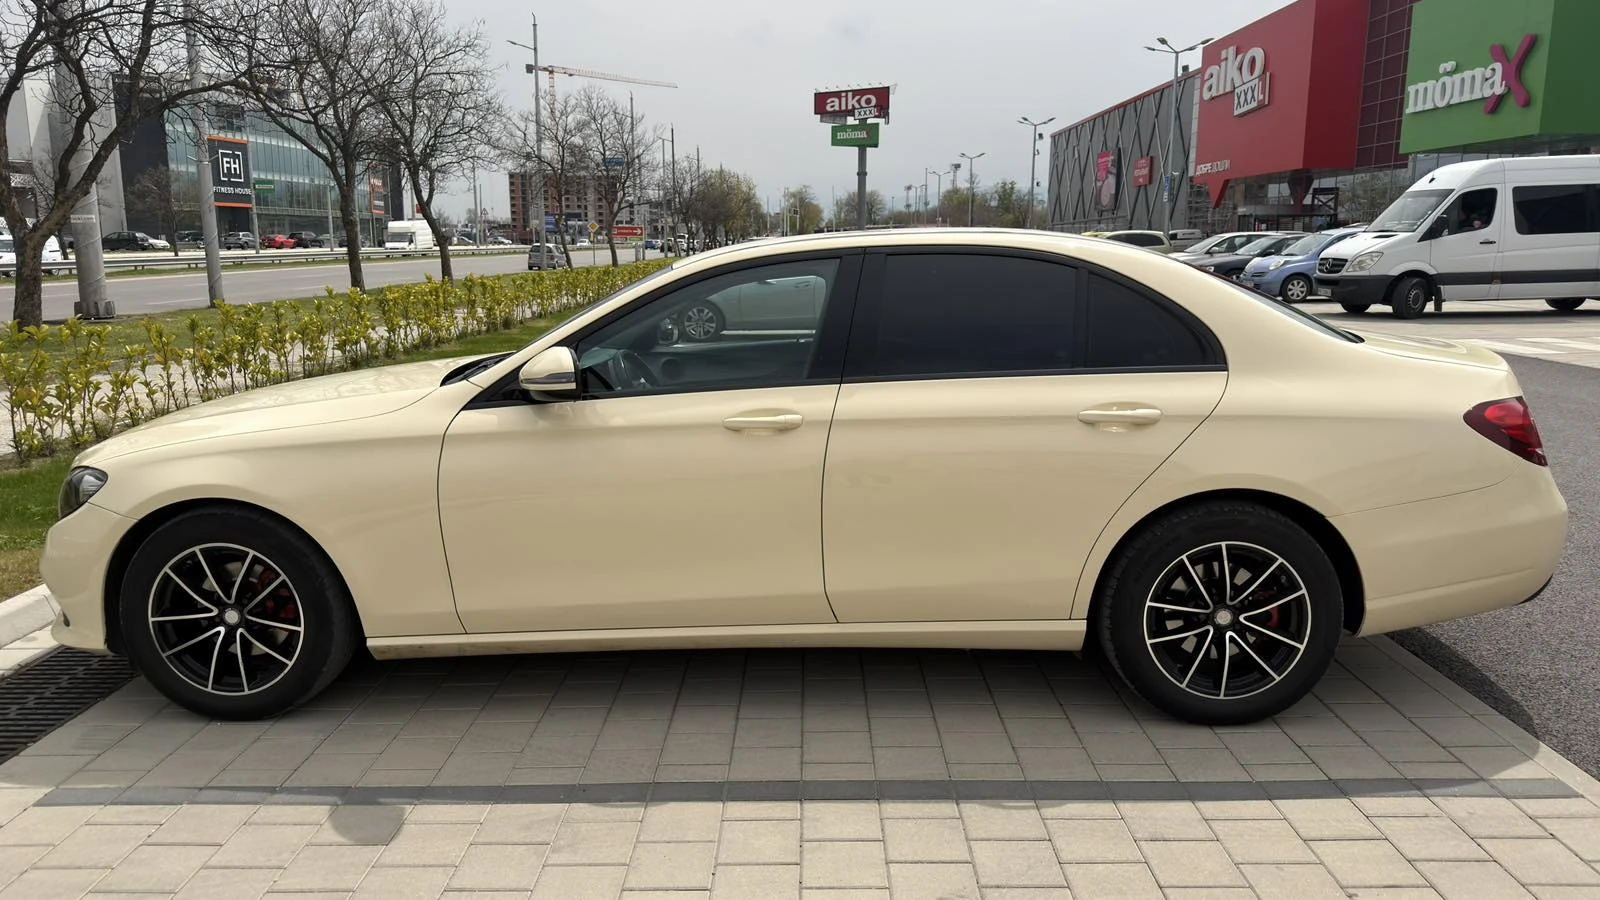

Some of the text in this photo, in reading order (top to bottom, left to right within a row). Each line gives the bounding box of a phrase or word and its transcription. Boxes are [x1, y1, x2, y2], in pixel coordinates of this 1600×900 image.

[1203, 45, 1265, 101] aiko
[826, 92, 876, 112] aiko
[1235, 79, 1264, 111] XXXL
[858, 107, 880, 117] XXXL
[222, 157, 240, 175] FH
[213, 186, 252, 195] FITNESS HOUSE
